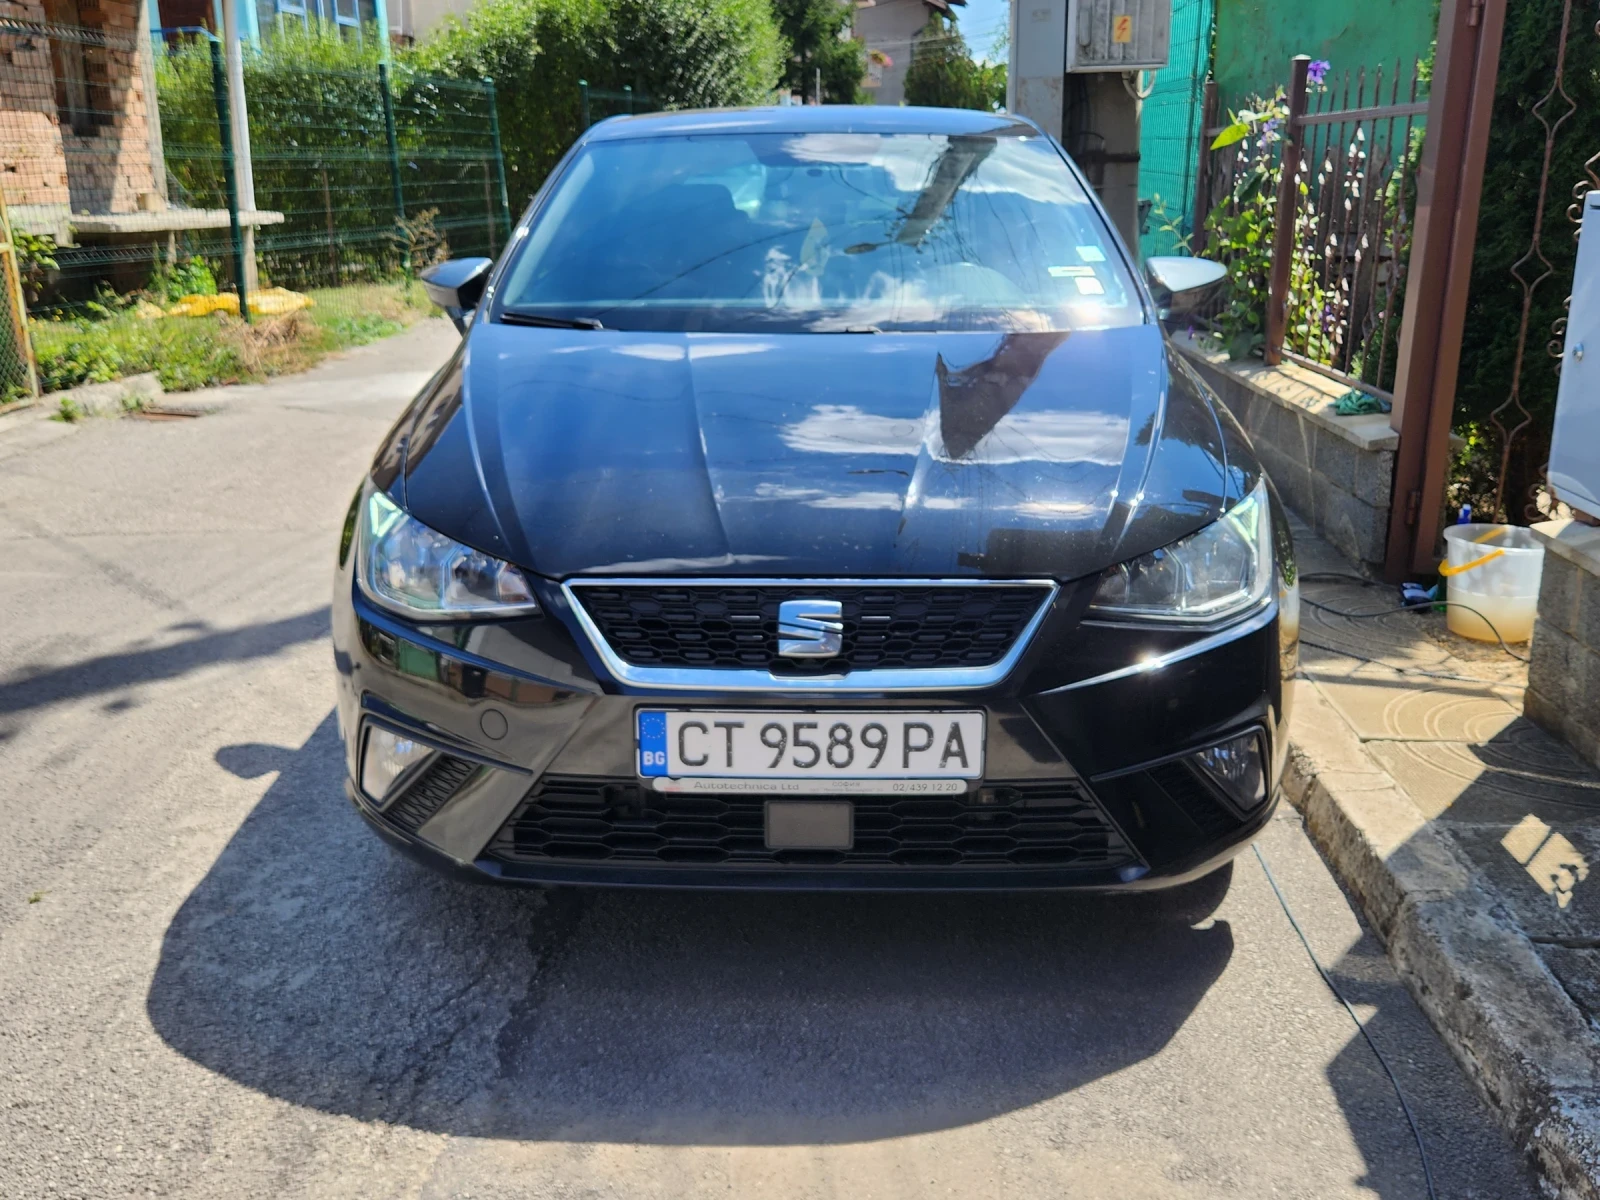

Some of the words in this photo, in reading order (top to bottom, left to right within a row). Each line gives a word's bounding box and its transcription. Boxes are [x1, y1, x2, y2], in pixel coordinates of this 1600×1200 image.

[678, 720, 745, 768] CT
[760, 722, 888, 769] 9589
[902, 722, 969, 769] PA
[643, 750, 665, 765] BG
[694, 781, 777, 790] Autotechnica
[781, 783, 800, 791] Ltd
